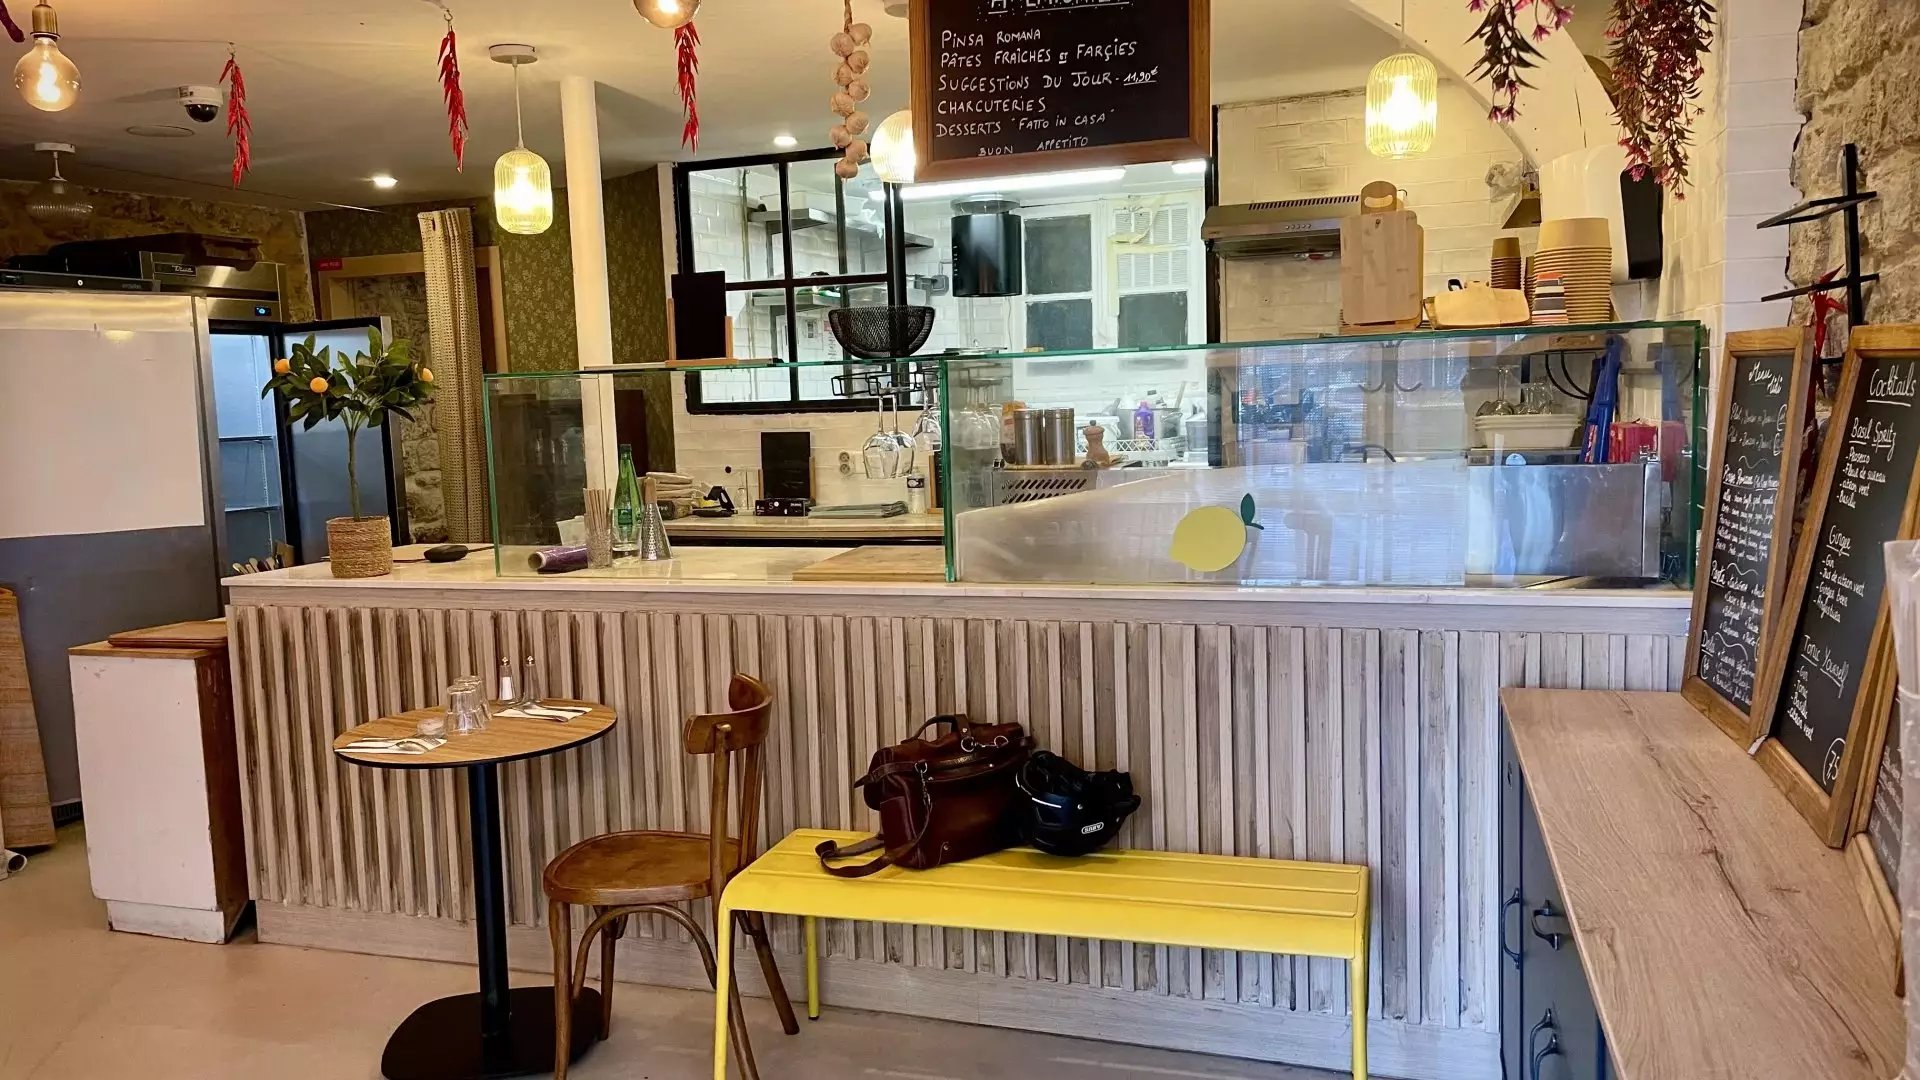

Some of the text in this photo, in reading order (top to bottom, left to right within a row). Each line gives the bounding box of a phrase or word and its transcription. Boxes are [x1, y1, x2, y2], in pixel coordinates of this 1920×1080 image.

[941, 28, 1041, 49] PINSA ROMANA
[941, 52, 982, 68] PÂTES
[994, 48, 1051, 65] FRAÎCHES
[1076, 38, 1138, 61] FARÇIES
[938, 74, 1030, 93] SUGGESTIONS
[1043, 75, 1062, 88] DU
[1071, 71, 1112, 87] JOUR
[937, 96, 1046, 115] CHARCUTERIES
[936, 121, 1001, 138] DESSERTS
[1055, 115, 1067, 127] IN
[978, 134, 1089, 157] BUON APPETITO
[1869, 362, 1917, 397] Cocktails
[1851, 417, 1897, 462] Basil Spritz
[1859, 466, 1867, 480] de
[1829, 525, 1852, 557] Ginger
[1831, 570, 1838, 584] de
[1837, 573, 1853, 591] citron
[1804, 634, 1850, 699] Tonic Yourself
[1081, 821, 1105, 834] ABUS
